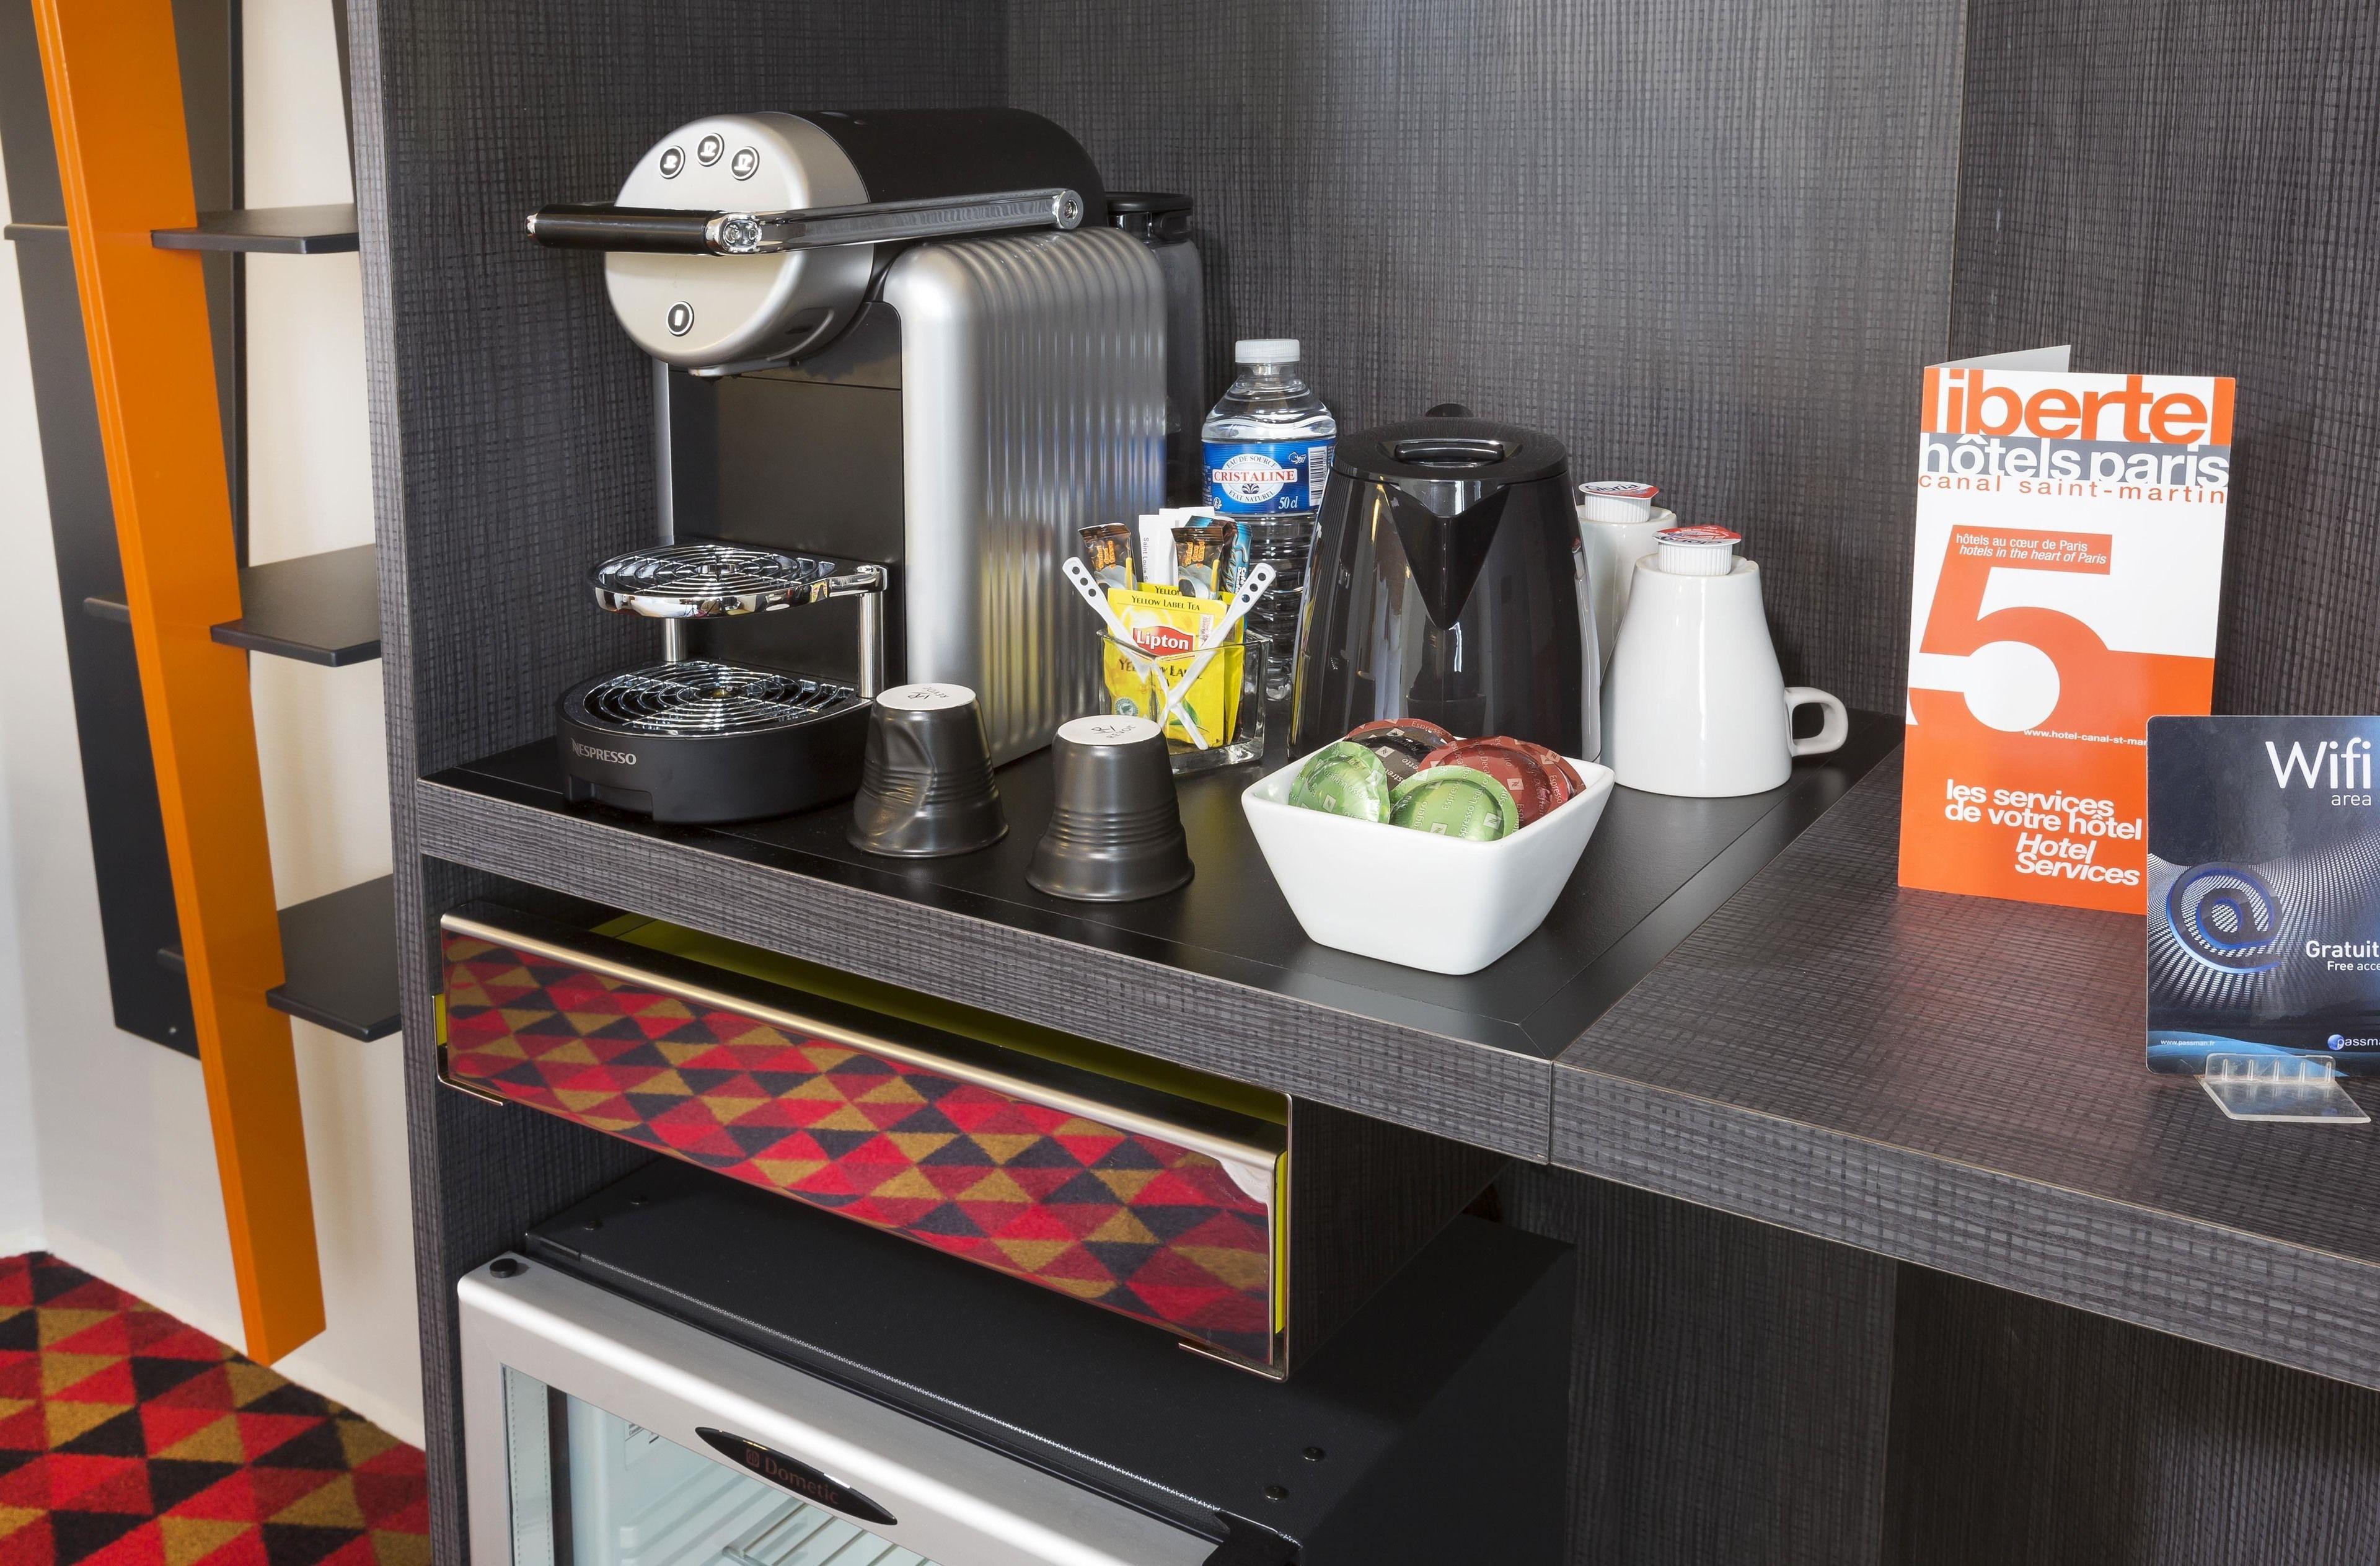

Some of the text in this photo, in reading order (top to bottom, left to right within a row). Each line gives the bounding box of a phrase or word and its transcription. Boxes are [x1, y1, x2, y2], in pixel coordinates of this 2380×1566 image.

[1922, 368, 2236, 446] libertel
[1226, 458, 1238, 469] EAU
[1250, 456, 1277, 468] SOURCE
[1919, 433, 2229, 487] hôtels paris
[1214, 471, 1295, 482] CRISTALINE
[1919, 474, 2225, 503] canal saint-martin
[1228, 490, 1275, 502] ETAT NATUREL
[1278, 496, 1298, 509] 50 cl
[1956, 533, 2088, 552] hôtels au cœur de Paris
[1959, 545, 2107, 565] hotels in the heart of Paris
[1136, 630, 1189, 650] Lipton
[2024, 729, 2147, 746] www.hotel-canal-st-mar
[571, 738, 637, 766] NESPRESSO
[2265, 737, 2371, 789] Wifi
[1549, 775, 1563, 804] Espresso
[1946, 779, 2115, 817] les services
[2331, 794, 2372, 806] area
[1945, 798, 2143, 841] de votre hôtel
[2016, 832, 2097, 863] Hotel
[2014, 852, 2140, 886] Services
[2306, 940, 2380, 958] Gratuit
[2327, 960, 2354, 971] Free
[765, 1458, 840, 1505] Dometic
